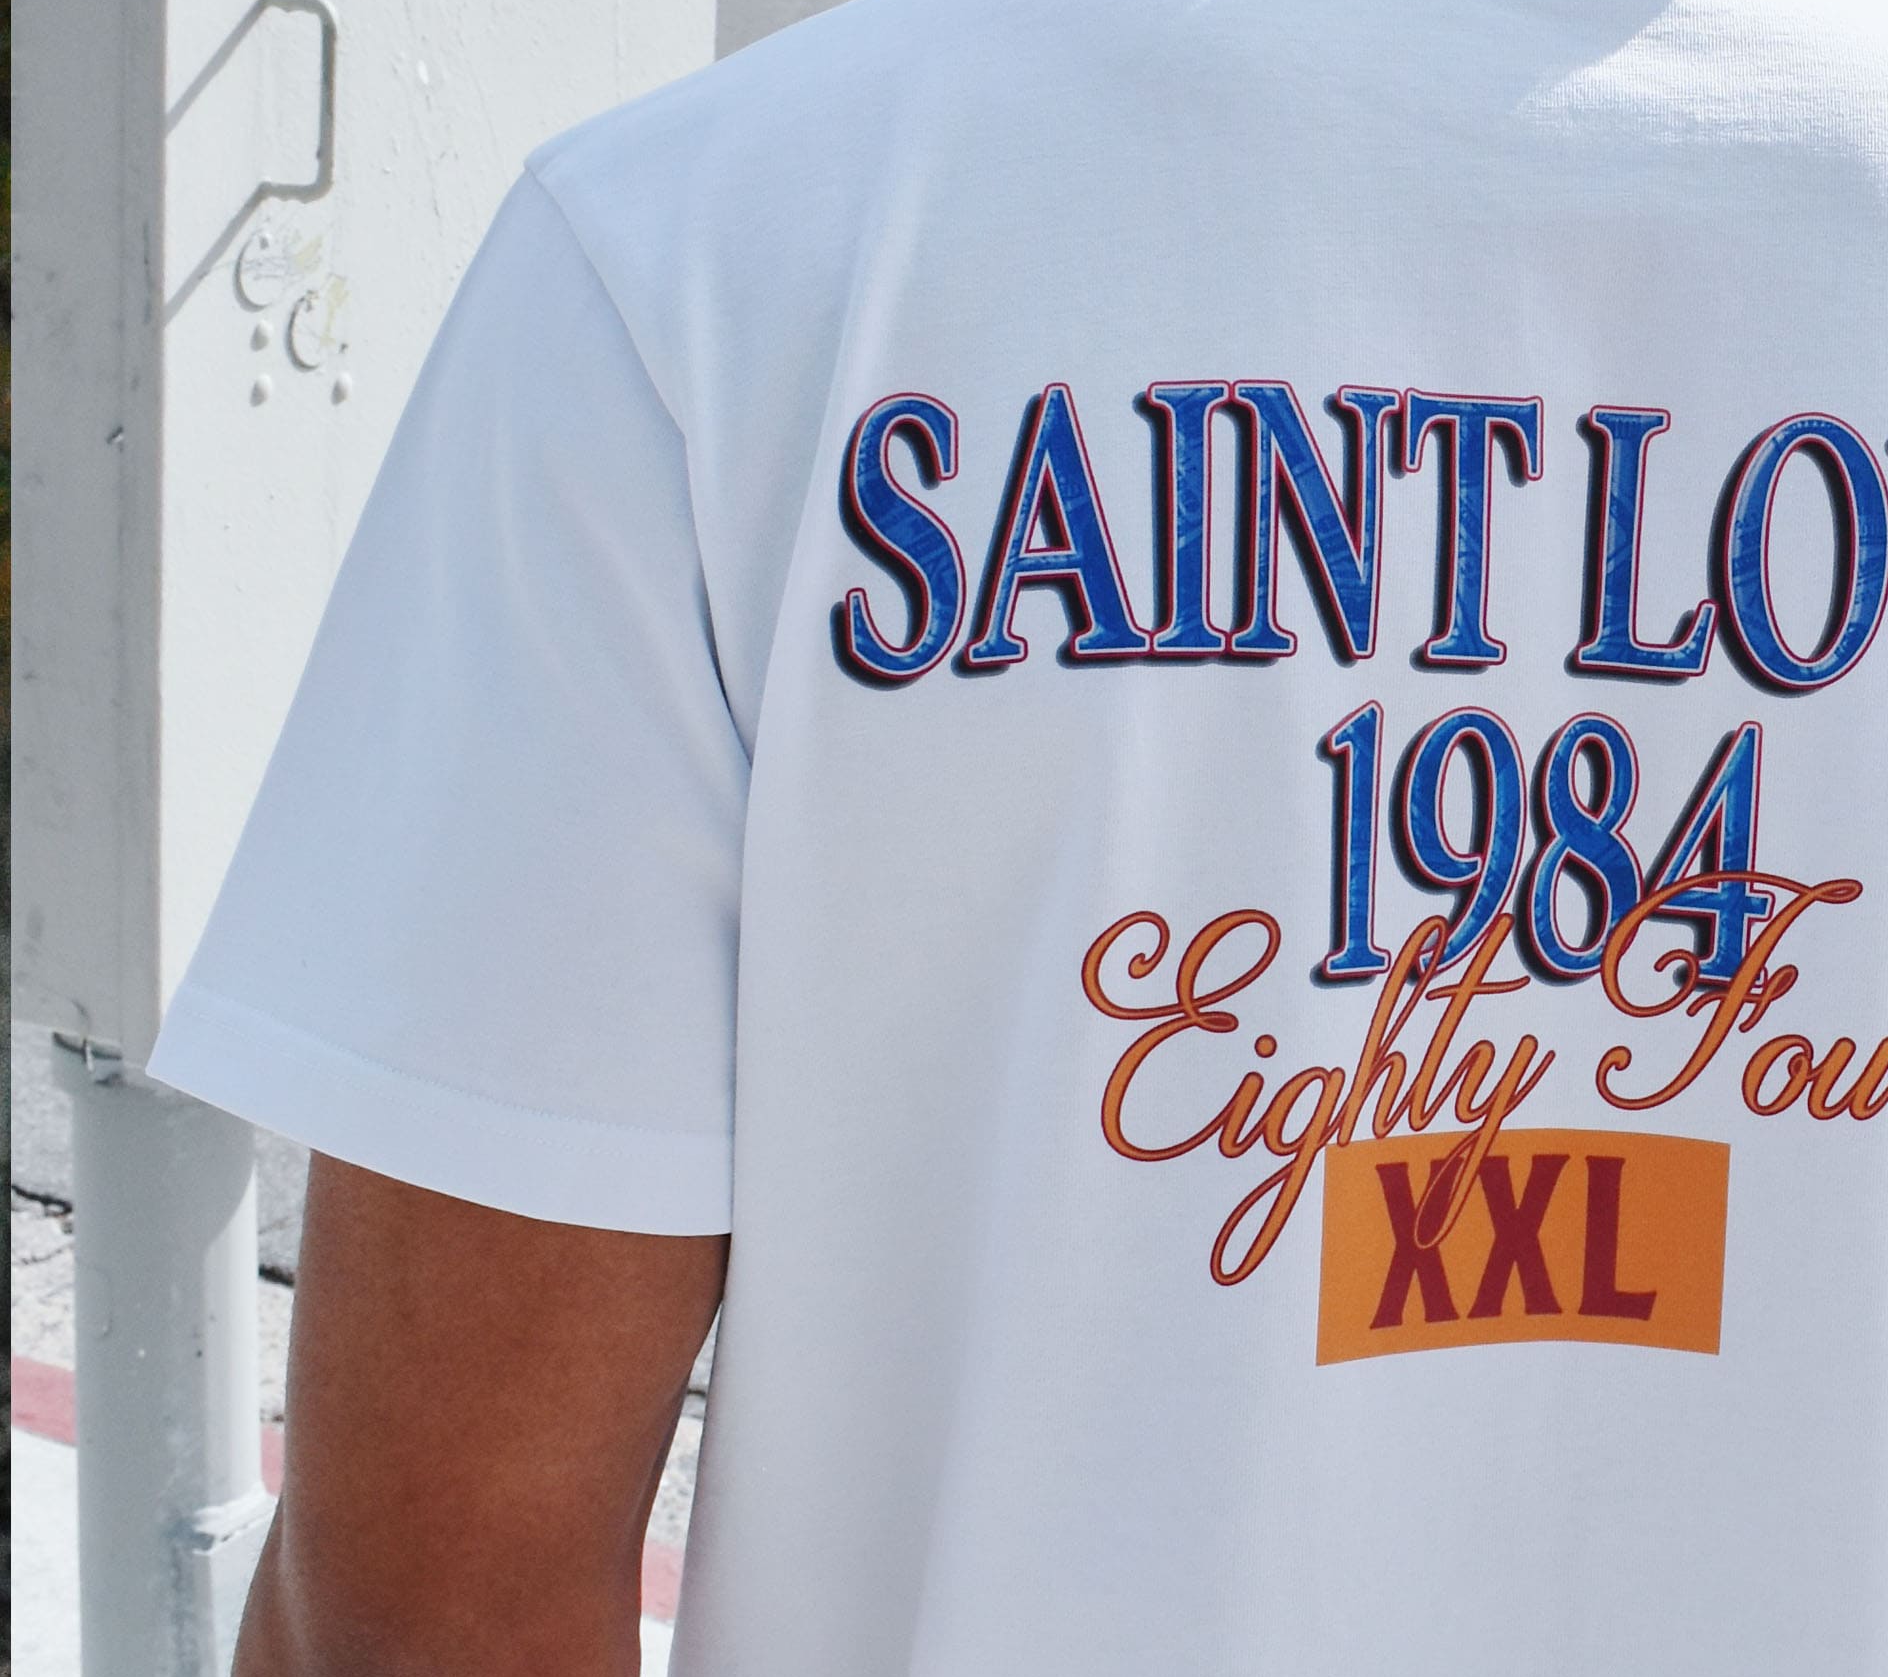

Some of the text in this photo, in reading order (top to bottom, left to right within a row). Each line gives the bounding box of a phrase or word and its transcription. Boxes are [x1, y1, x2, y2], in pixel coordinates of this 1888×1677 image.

[832, 380, 1544, 690] SAINT
[1310, 700, 1776, 990] 1984
[1081, 908, 1557, 1287] Eighty
[1369, 1153, 1658, 1331] XXL
